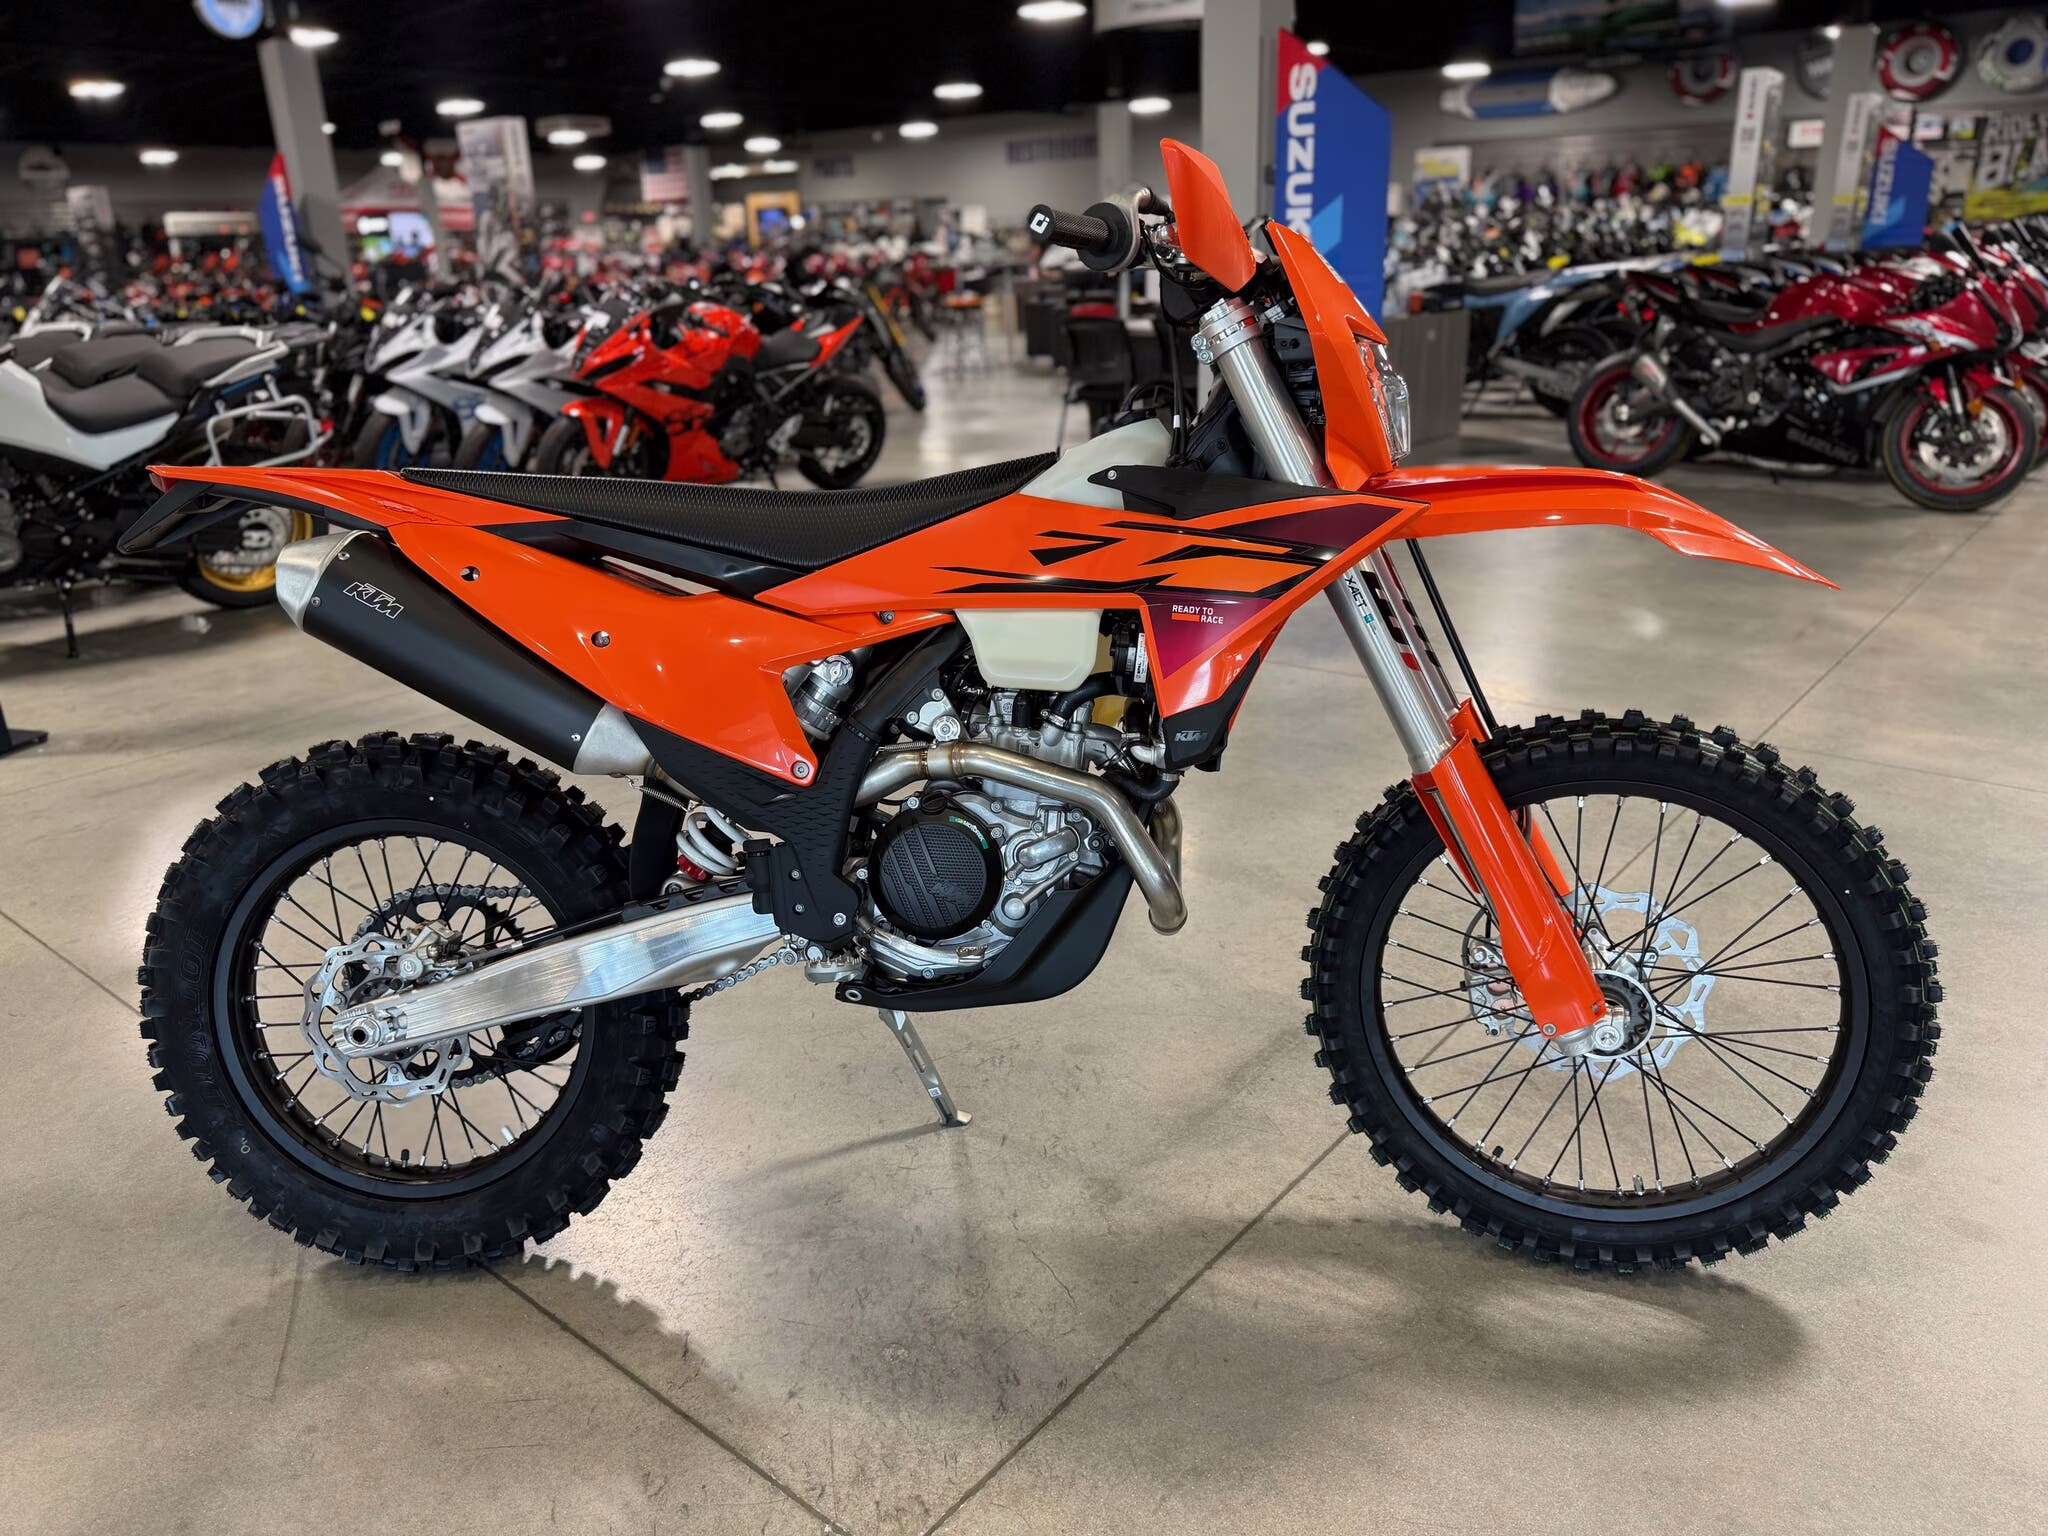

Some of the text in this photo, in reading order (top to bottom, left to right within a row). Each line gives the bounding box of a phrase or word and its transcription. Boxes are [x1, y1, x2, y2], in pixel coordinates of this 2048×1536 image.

[1285, 62, 1318, 243] SUZUK
[343, 581, 404, 619] KTM
[1344, 575, 1367, 608] XACT
[1172, 604, 1214, 615] READY TO
[1200, 615, 1224, 625] RACE
[1174, 730, 1208, 742] KTM
